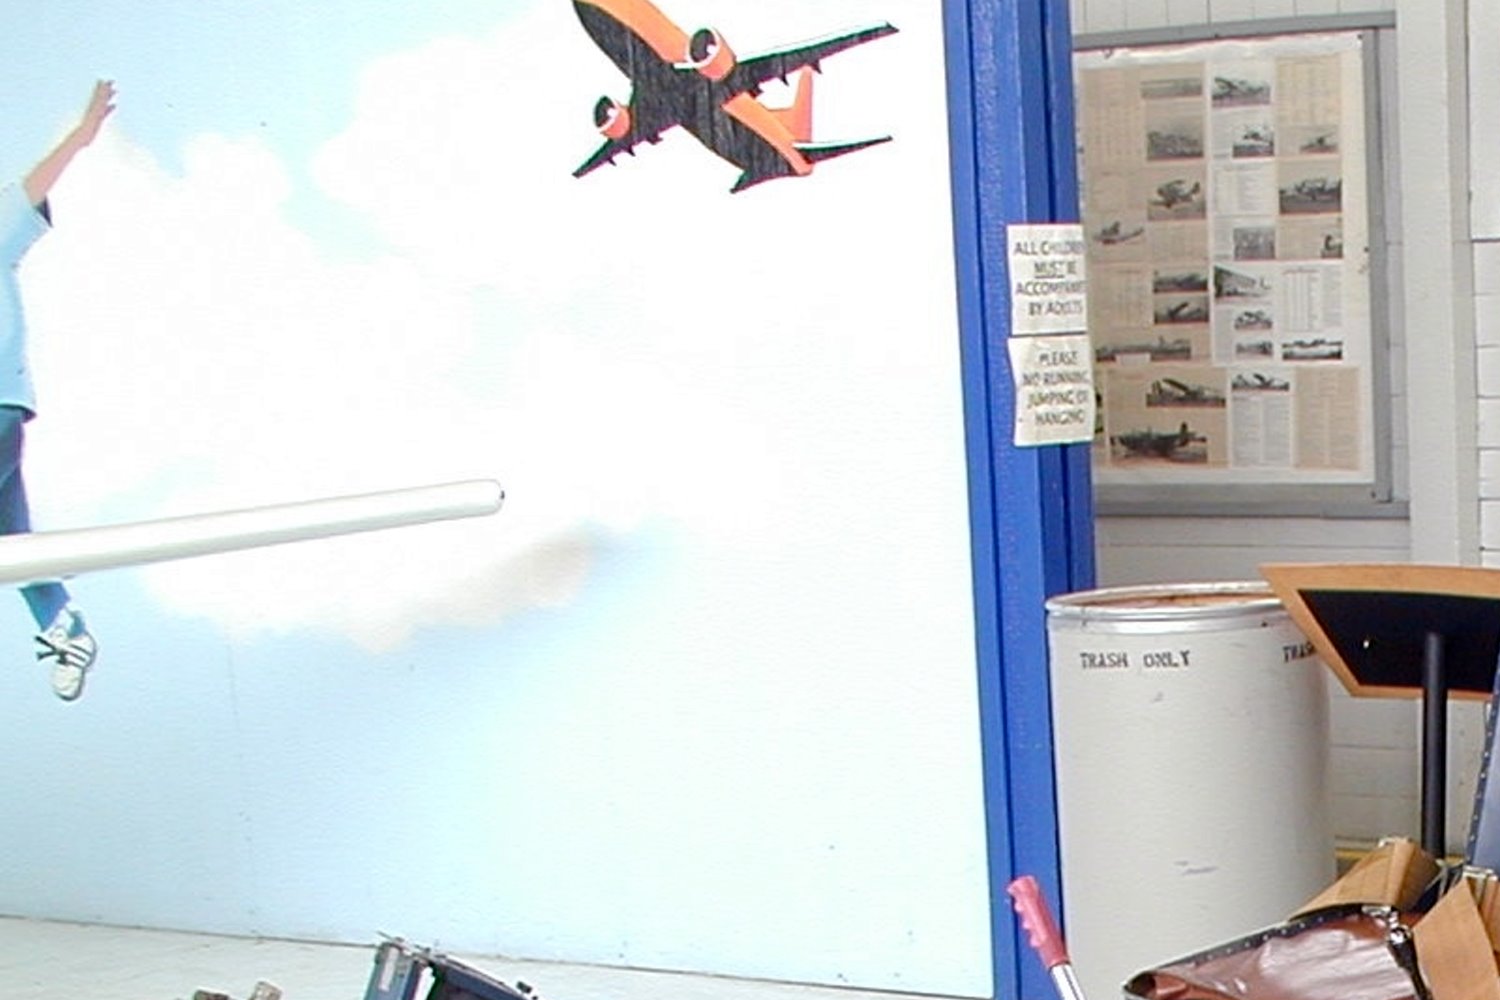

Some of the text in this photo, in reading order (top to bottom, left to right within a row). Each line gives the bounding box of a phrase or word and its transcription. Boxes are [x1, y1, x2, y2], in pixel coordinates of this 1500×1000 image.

[1013, 239, 1038, 257] ALL
[1039, 351, 1079, 366] PLEASE
[1079, 650, 1191, 670] TRASH ONLY
